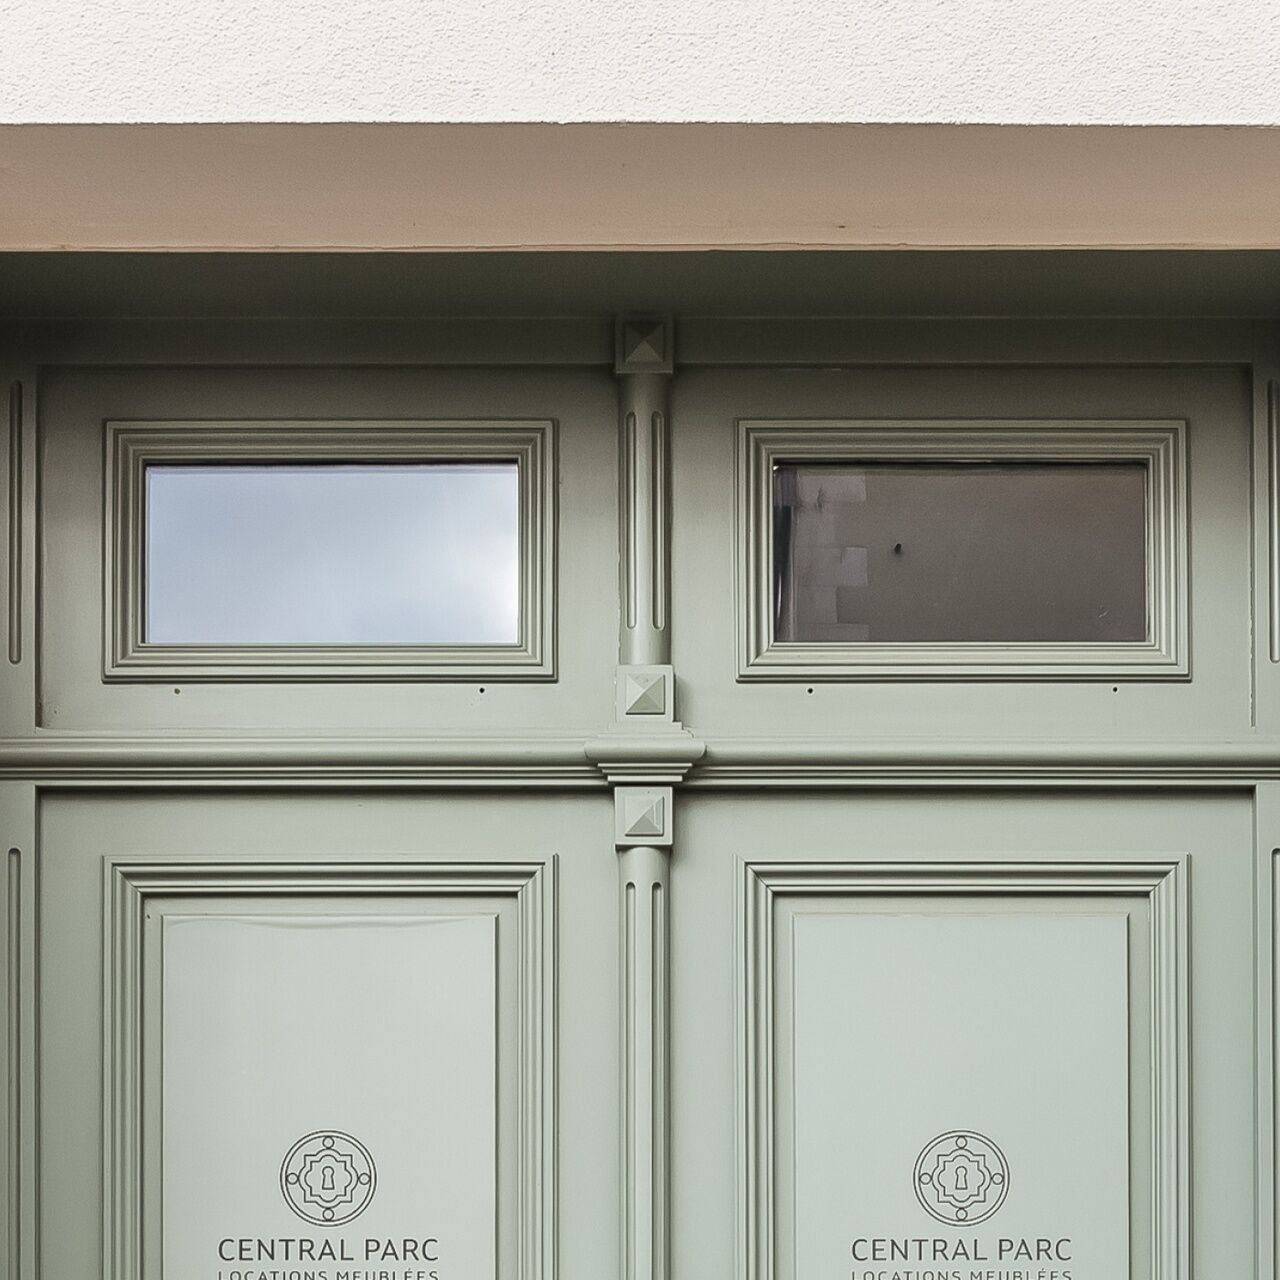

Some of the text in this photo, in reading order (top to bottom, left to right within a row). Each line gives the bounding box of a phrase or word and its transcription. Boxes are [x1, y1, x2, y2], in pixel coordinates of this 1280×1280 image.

[218, 1238, 439, 1262] CENTRAL PARC
[851, 1238, 1072, 1262] CENTRAL PARC
